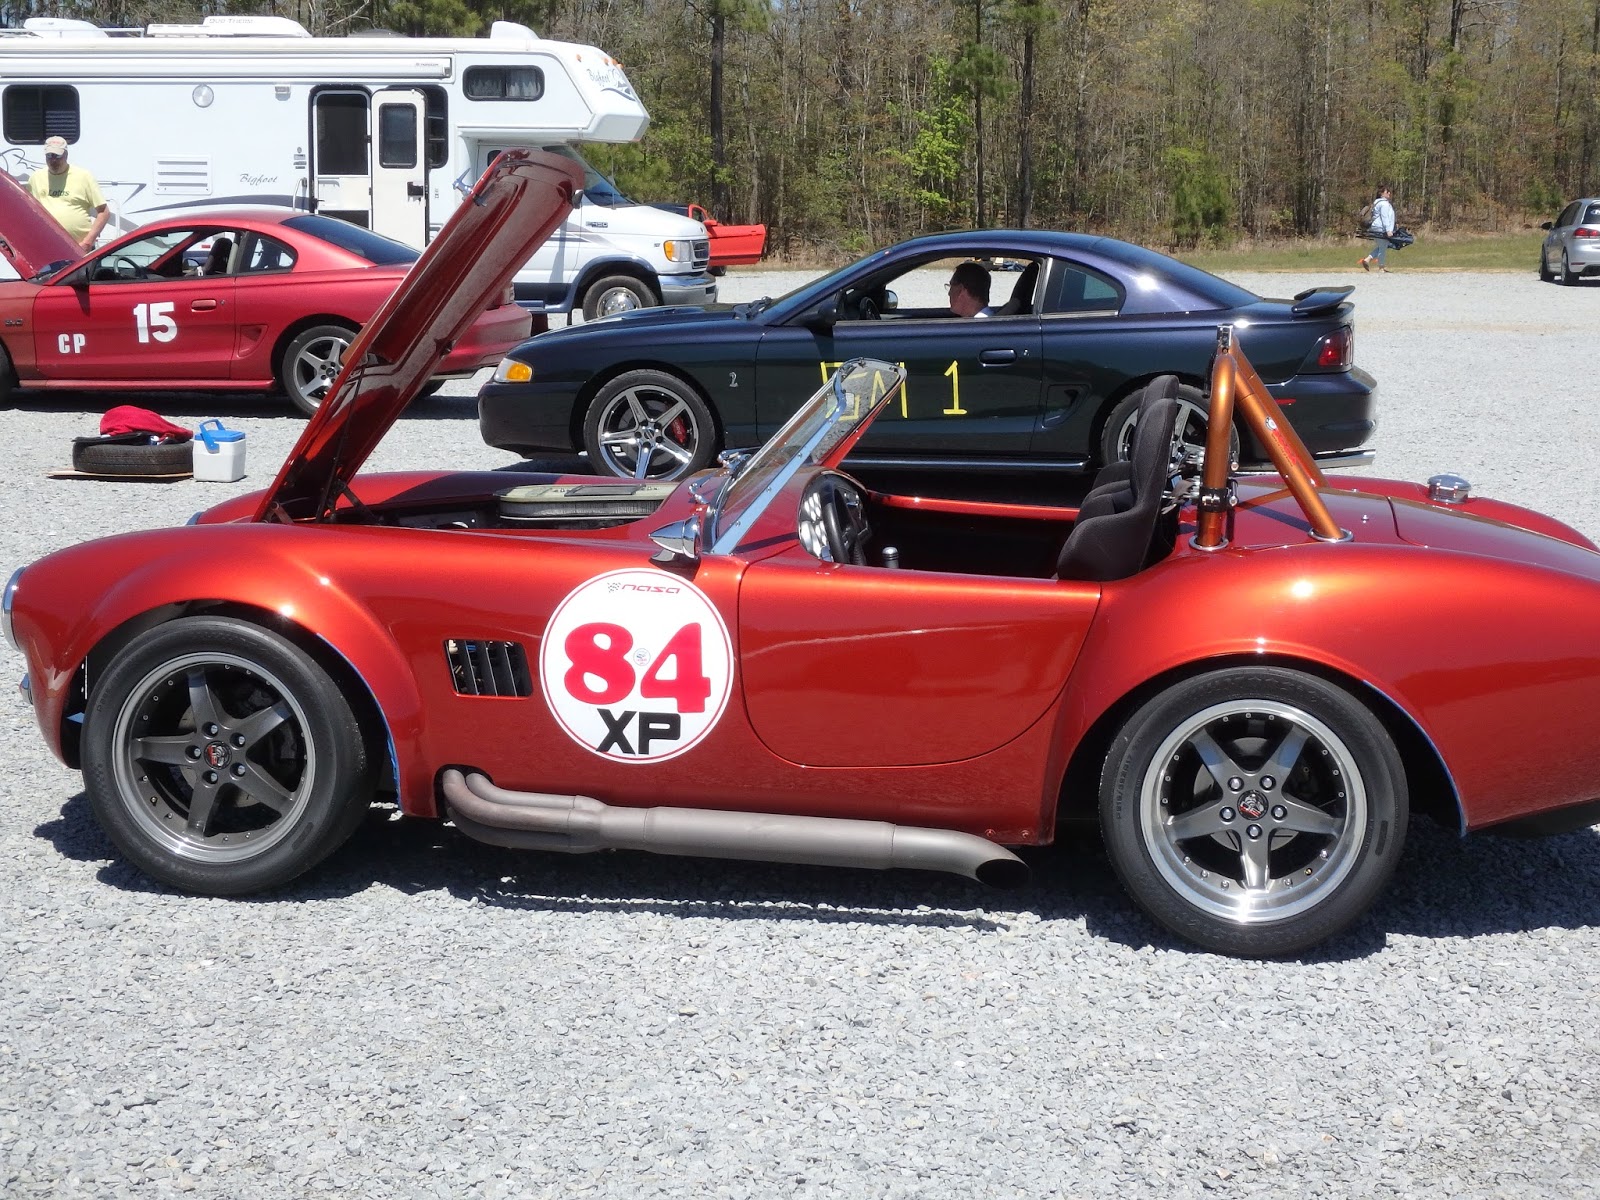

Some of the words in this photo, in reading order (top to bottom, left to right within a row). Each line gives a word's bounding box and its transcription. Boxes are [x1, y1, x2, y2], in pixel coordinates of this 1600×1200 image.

[239, 173, 278, 186] Bigfoot
[57, 333, 86, 354] CP
[133, 301, 178, 344] 15
[943, 360, 968, 415] 1
[563, 621, 712, 714] 84
[595, 707, 682, 756] XP
